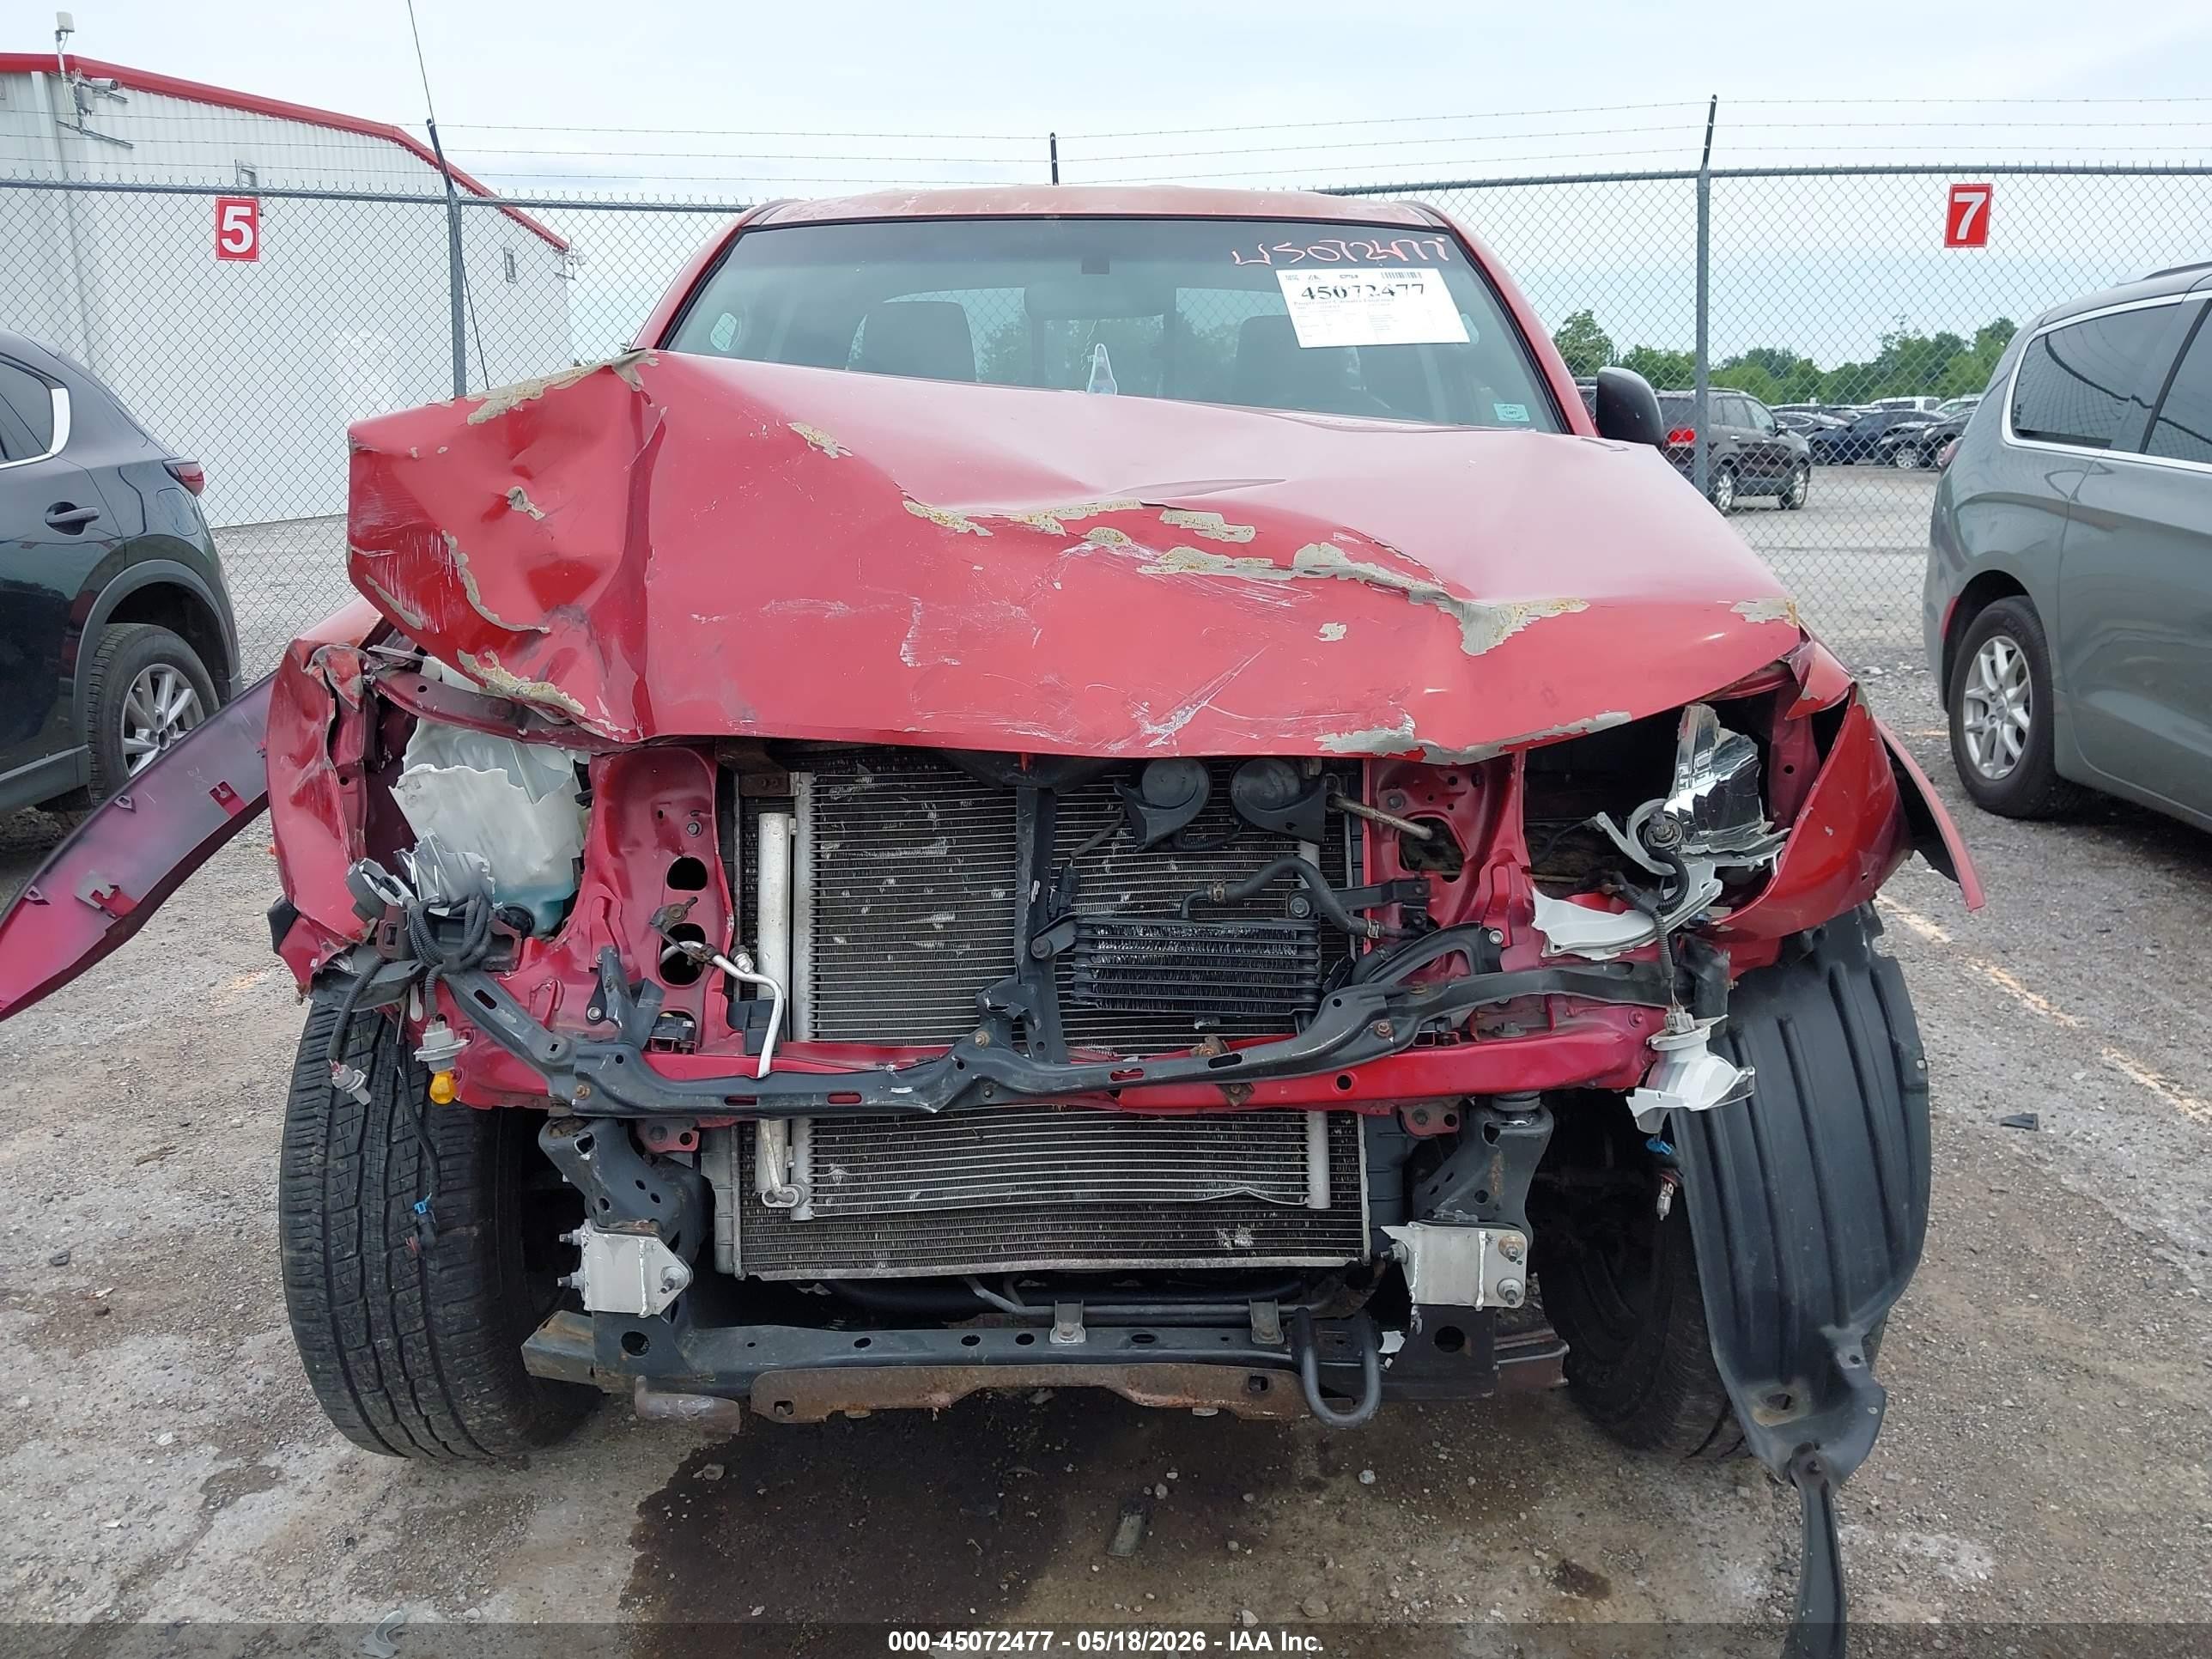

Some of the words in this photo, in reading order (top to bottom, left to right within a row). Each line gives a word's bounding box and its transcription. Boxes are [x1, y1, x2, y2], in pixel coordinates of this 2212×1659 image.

[221, 205, 254, 253] 5
[1954, 192, 1987, 240] 7
[1301, 283, 1425, 300] 45072477
